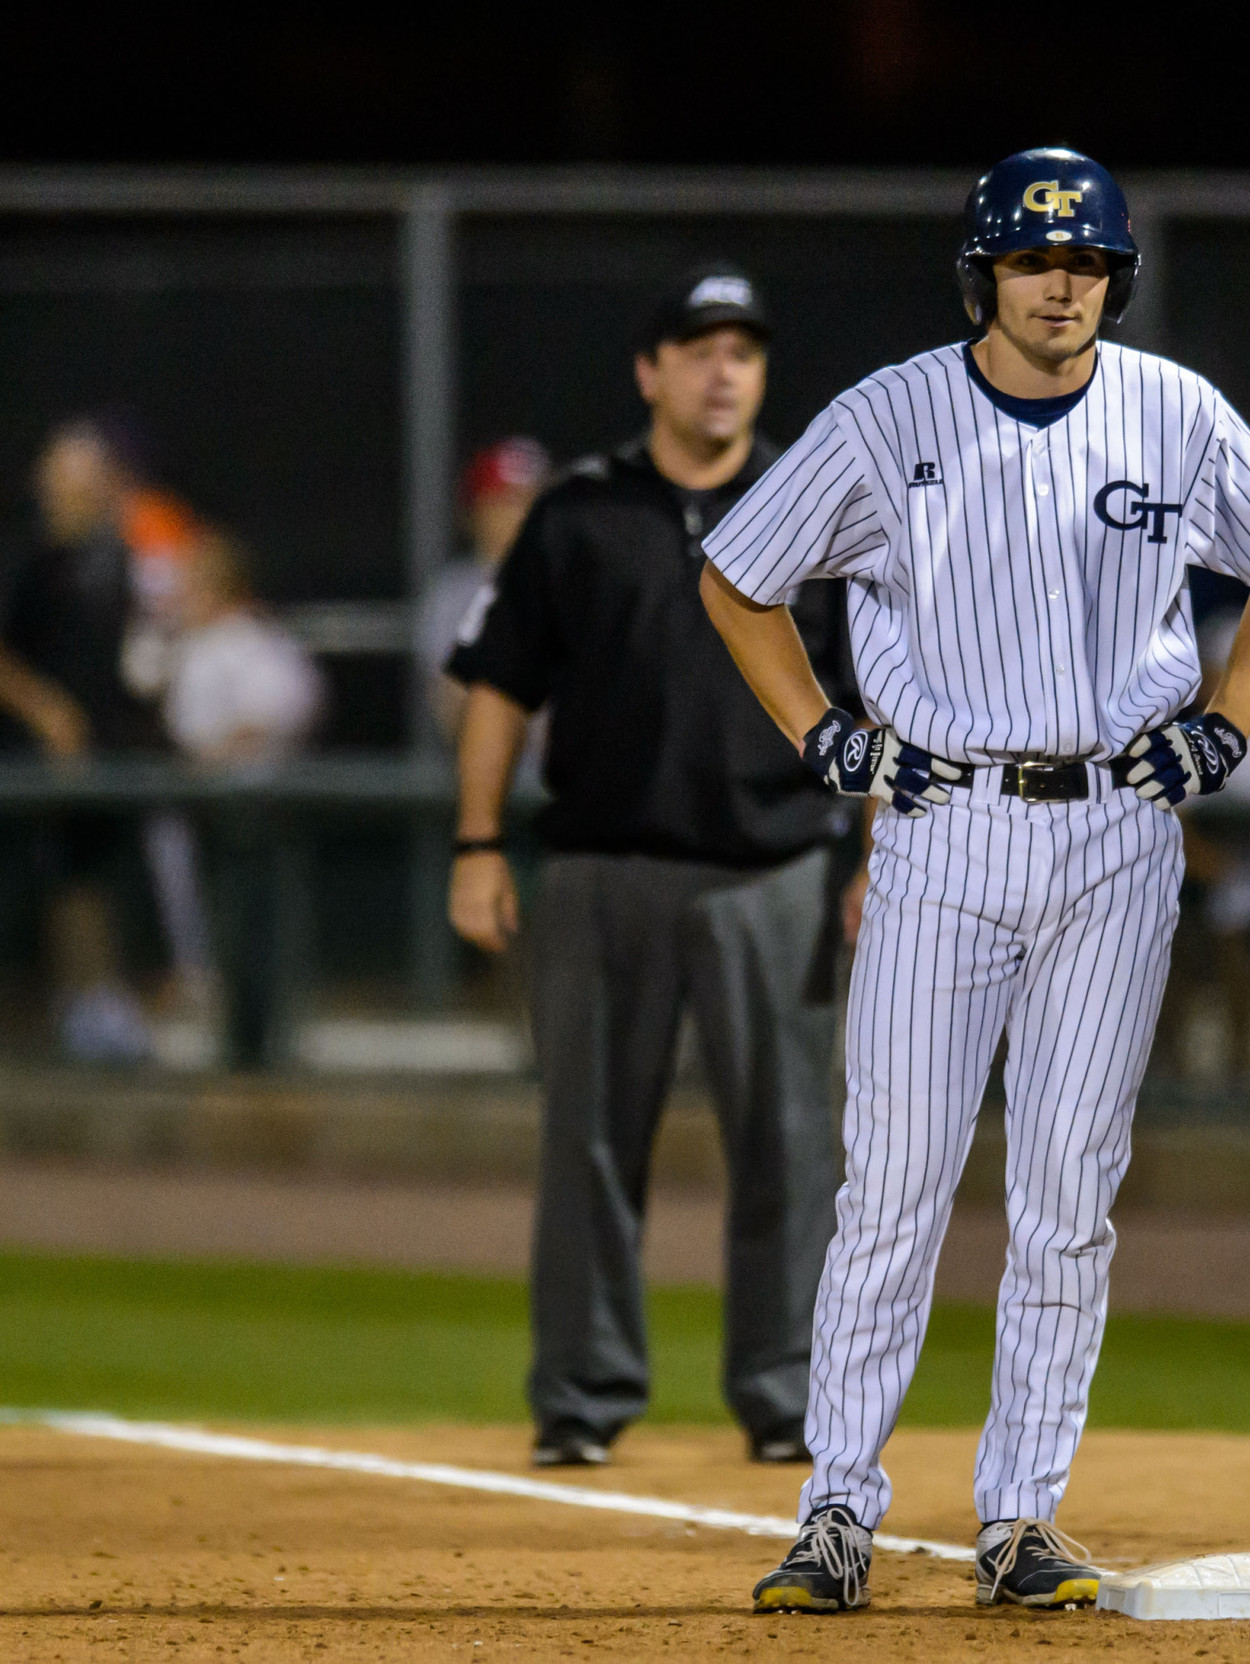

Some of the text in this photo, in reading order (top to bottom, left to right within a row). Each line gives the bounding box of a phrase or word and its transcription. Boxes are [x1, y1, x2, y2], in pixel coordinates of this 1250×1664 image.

[1023, 181, 1083, 217] GT
[914, 462, 936, 481] R
[1094, 480, 1183, 544] GT
